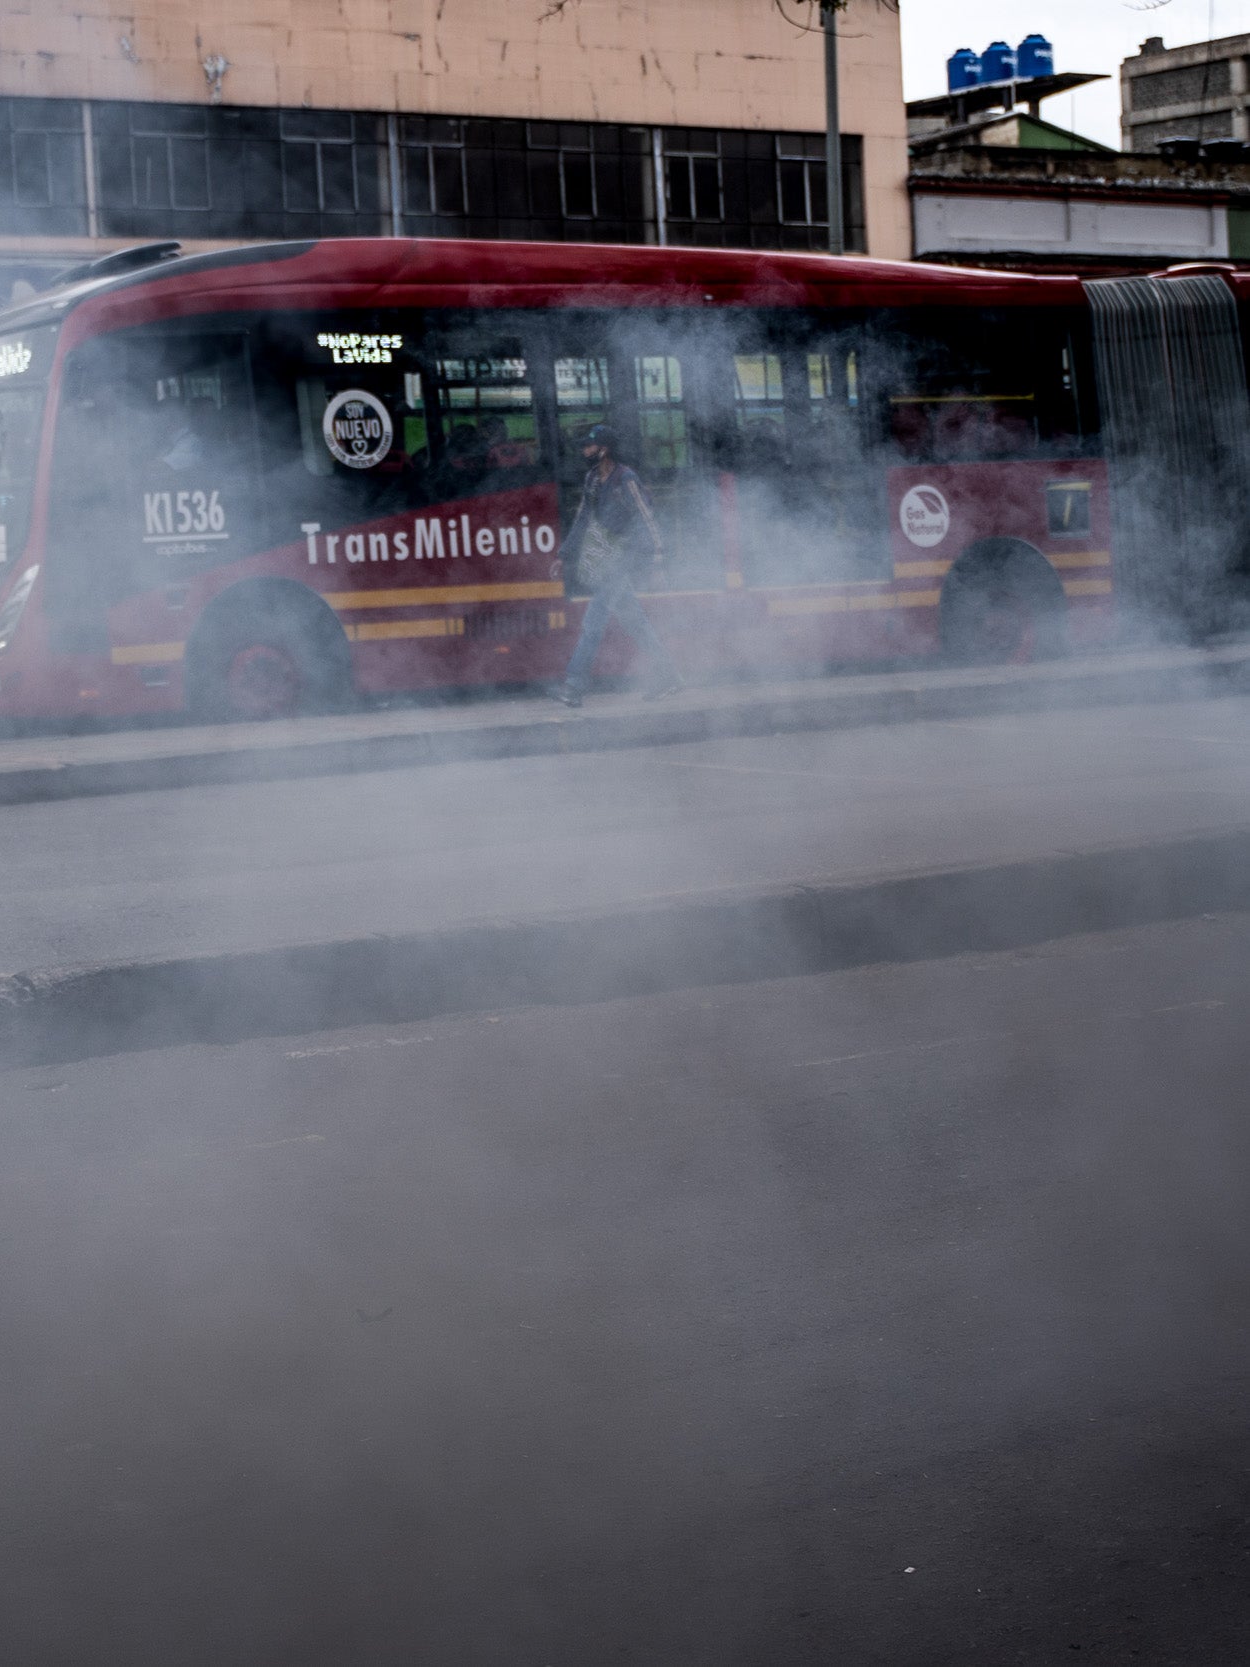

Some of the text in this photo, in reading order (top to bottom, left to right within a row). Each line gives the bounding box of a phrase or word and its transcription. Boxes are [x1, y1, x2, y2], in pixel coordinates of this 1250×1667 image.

[317, 333, 403, 349] #NoPares
[332, 348, 392, 363] LaVida
[345, 402, 364, 418] SOY
[335, 420, 381, 440] NUEVO
[143, 490, 225, 534] K1536
[907, 506, 925, 519] Gas
[301, 515, 556, 565] TransMilenio
